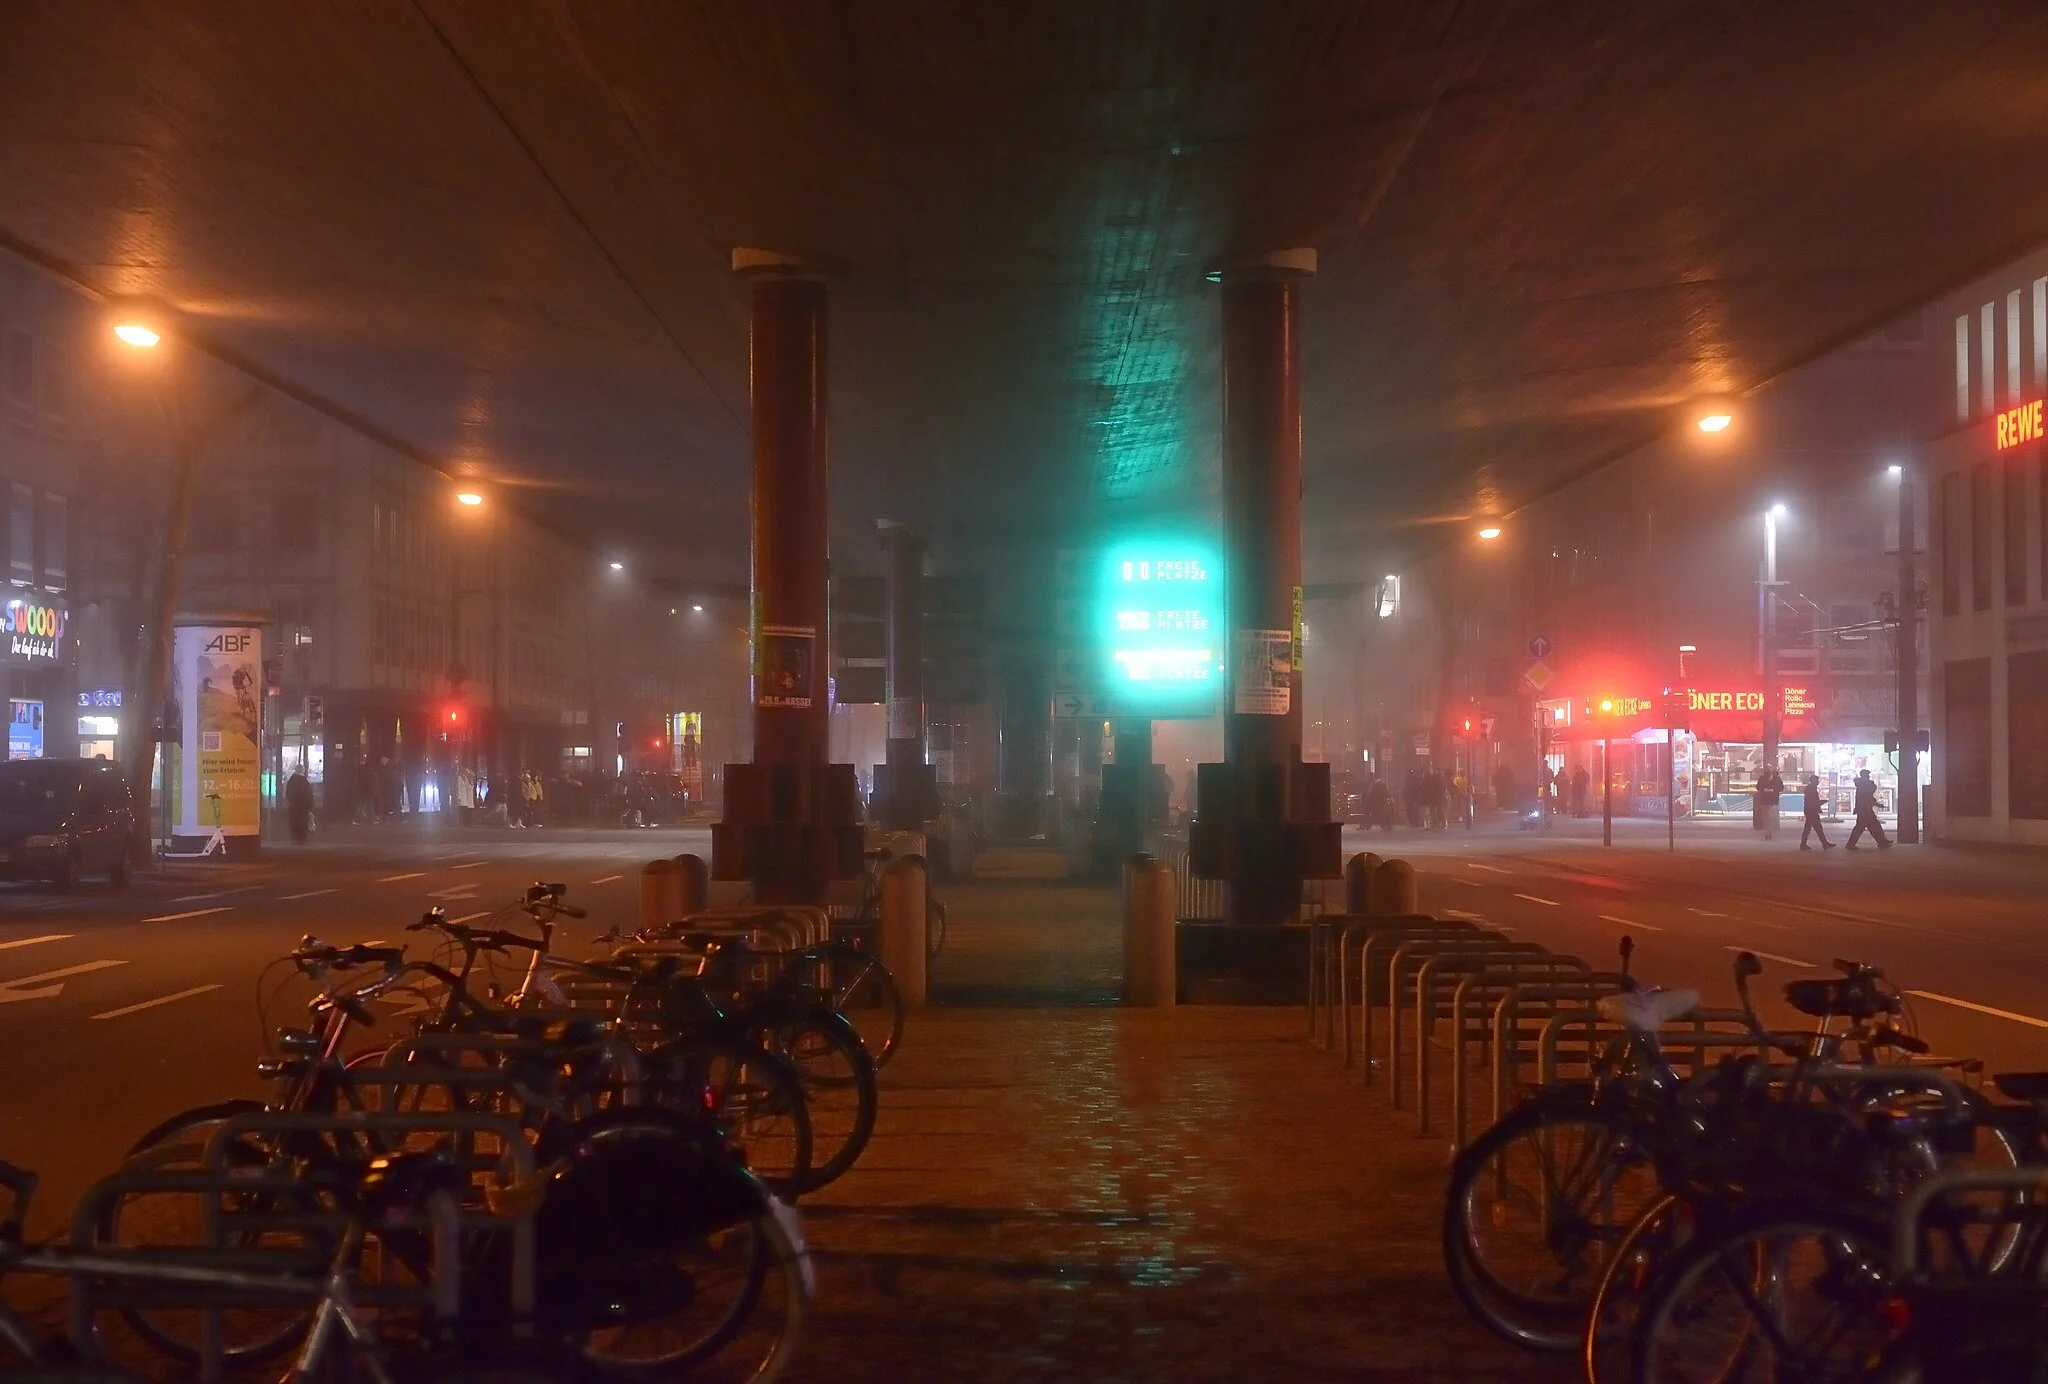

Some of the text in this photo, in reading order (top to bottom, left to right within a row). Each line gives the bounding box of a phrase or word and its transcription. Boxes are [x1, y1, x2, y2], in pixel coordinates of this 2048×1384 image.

[1997, 399, 2044, 451] REWE
[1157, 561, 1199, 570] FREIE
[1158, 611, 1199, 620] FREIE
[204, 635, 251, 652] ABF
[1674, 689, 1765, 711] ÖNER ECK
